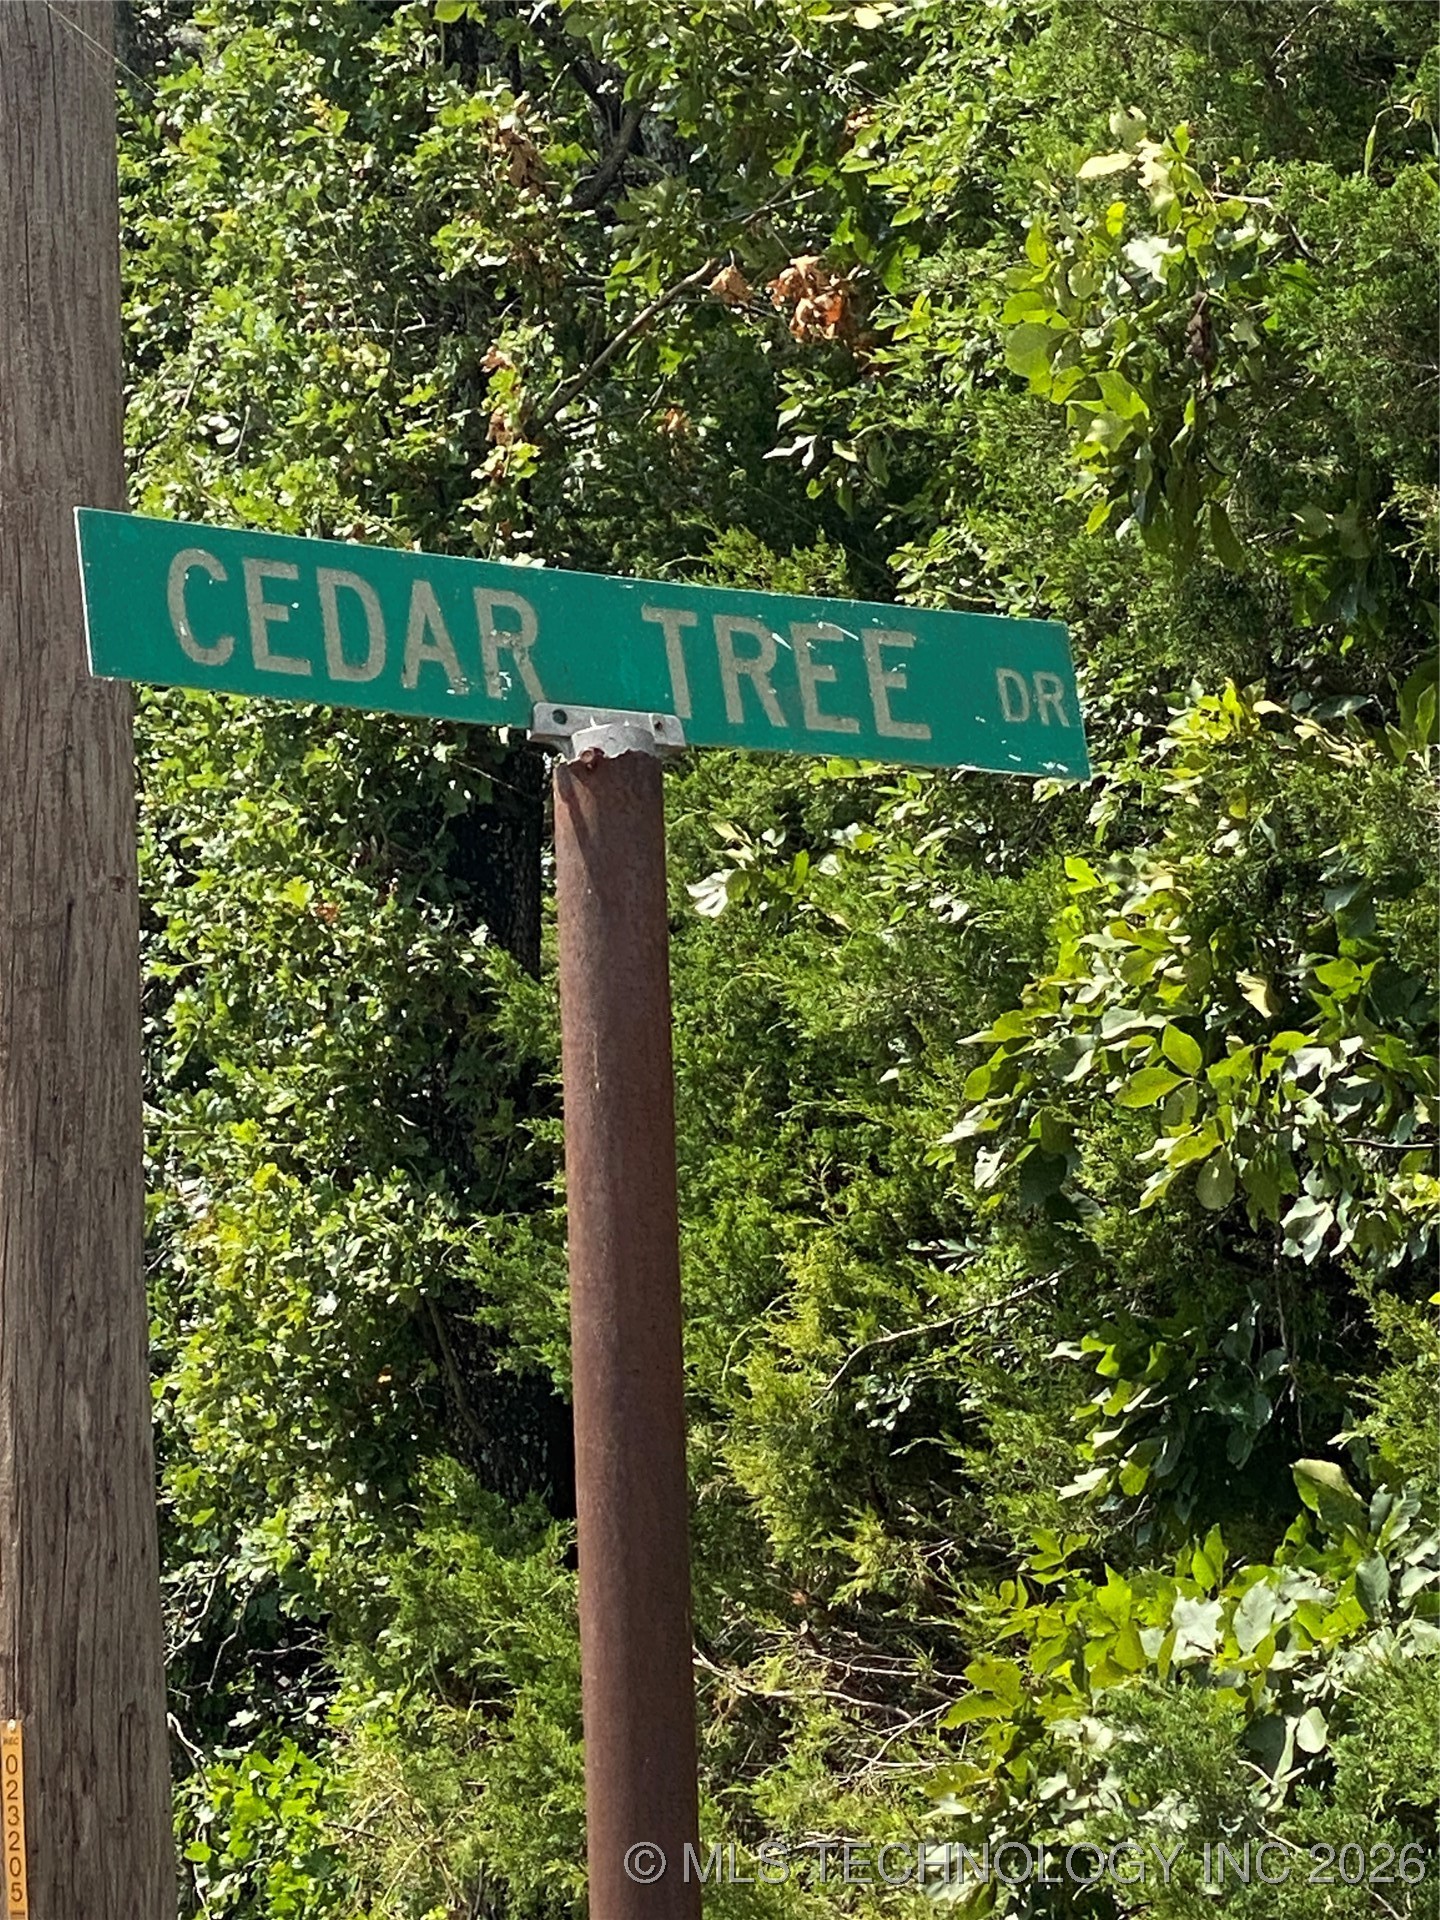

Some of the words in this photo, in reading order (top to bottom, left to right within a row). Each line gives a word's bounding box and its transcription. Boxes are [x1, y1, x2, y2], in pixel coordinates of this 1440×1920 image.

[167, 548, 548, 702] CEDAR
[641, 603, 932, 740] TREE
[996, 667, 1071, 728] DR
